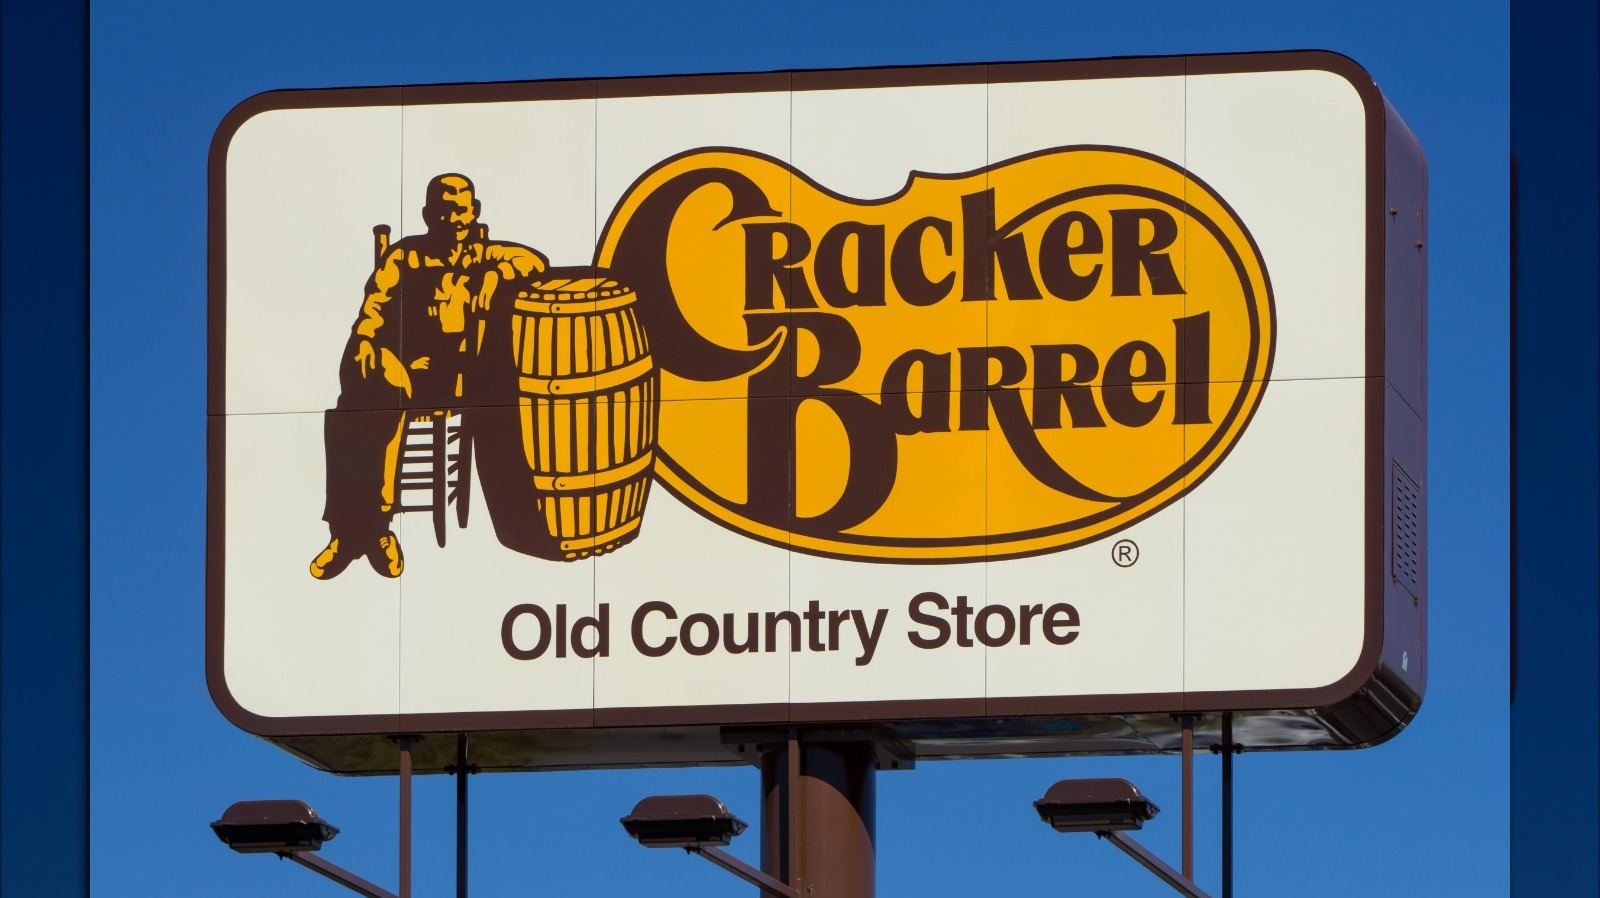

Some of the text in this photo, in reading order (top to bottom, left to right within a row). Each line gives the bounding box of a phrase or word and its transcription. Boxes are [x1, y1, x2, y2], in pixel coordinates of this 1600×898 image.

[501, 592, 1080, 666] Old Country Store
